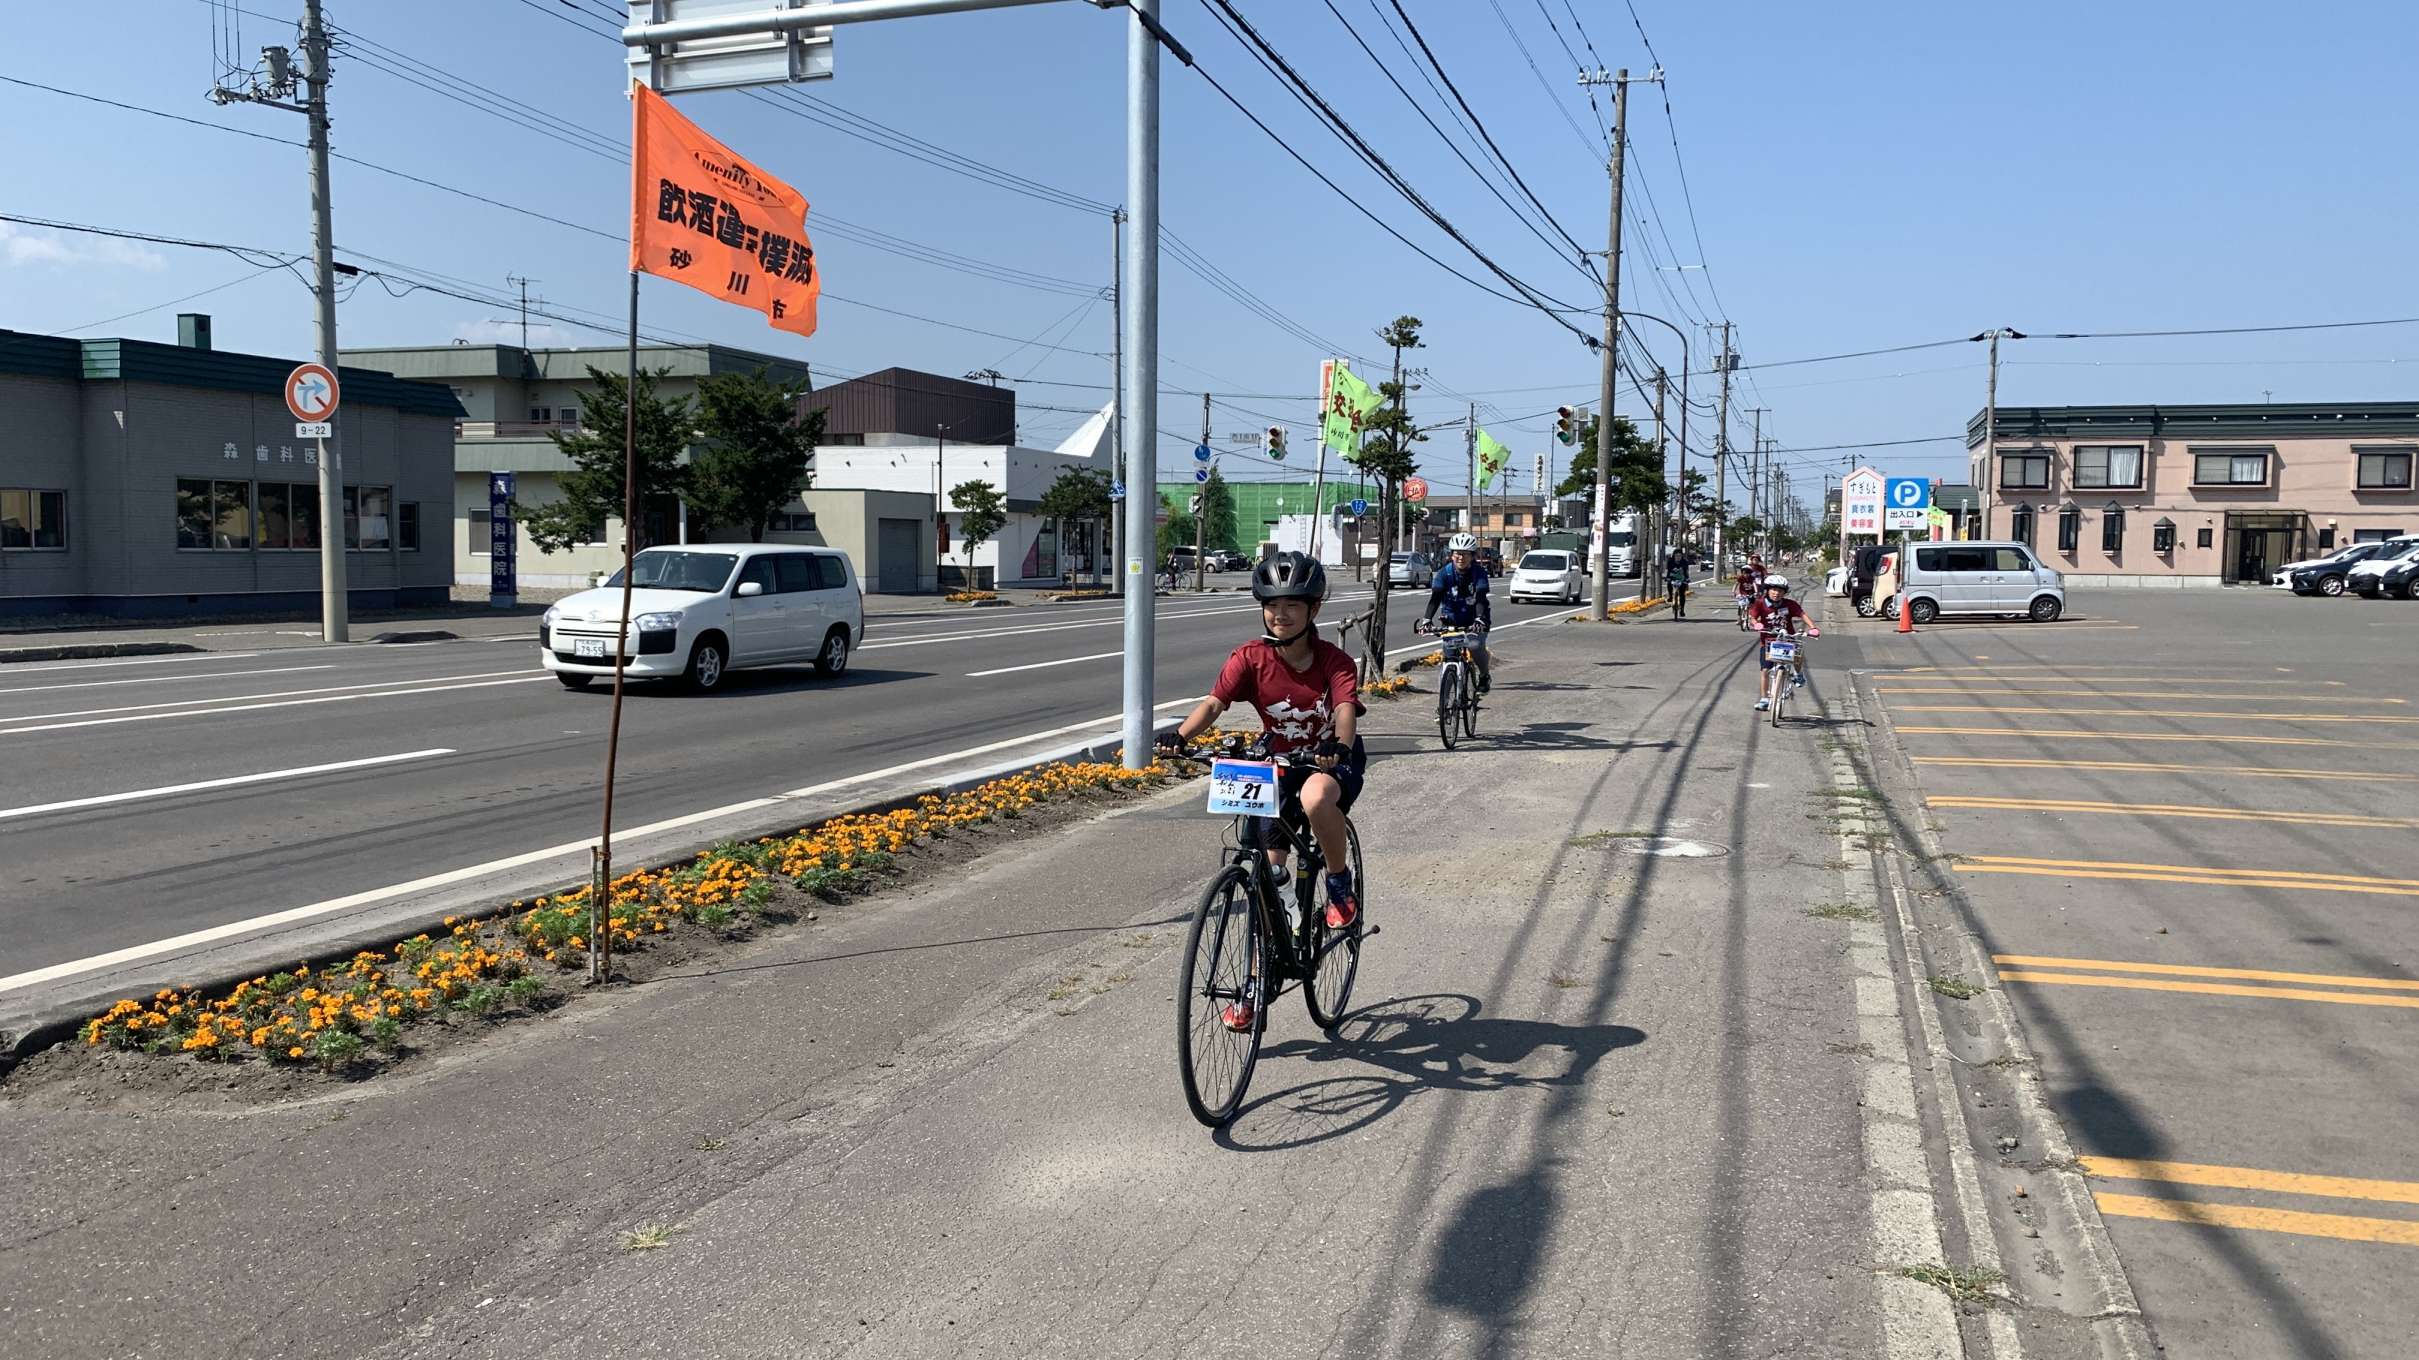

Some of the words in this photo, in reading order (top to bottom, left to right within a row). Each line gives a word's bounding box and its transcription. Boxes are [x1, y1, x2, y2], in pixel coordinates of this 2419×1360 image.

[300, 425, 326, 435] 9-22
[223, 442, 342, 470] 森歯科医
[1889, 510, 1915, 519] 出入口
[1850, 518, 1874, 529] 美容室
[1241, 782, 1262, 800] 21
